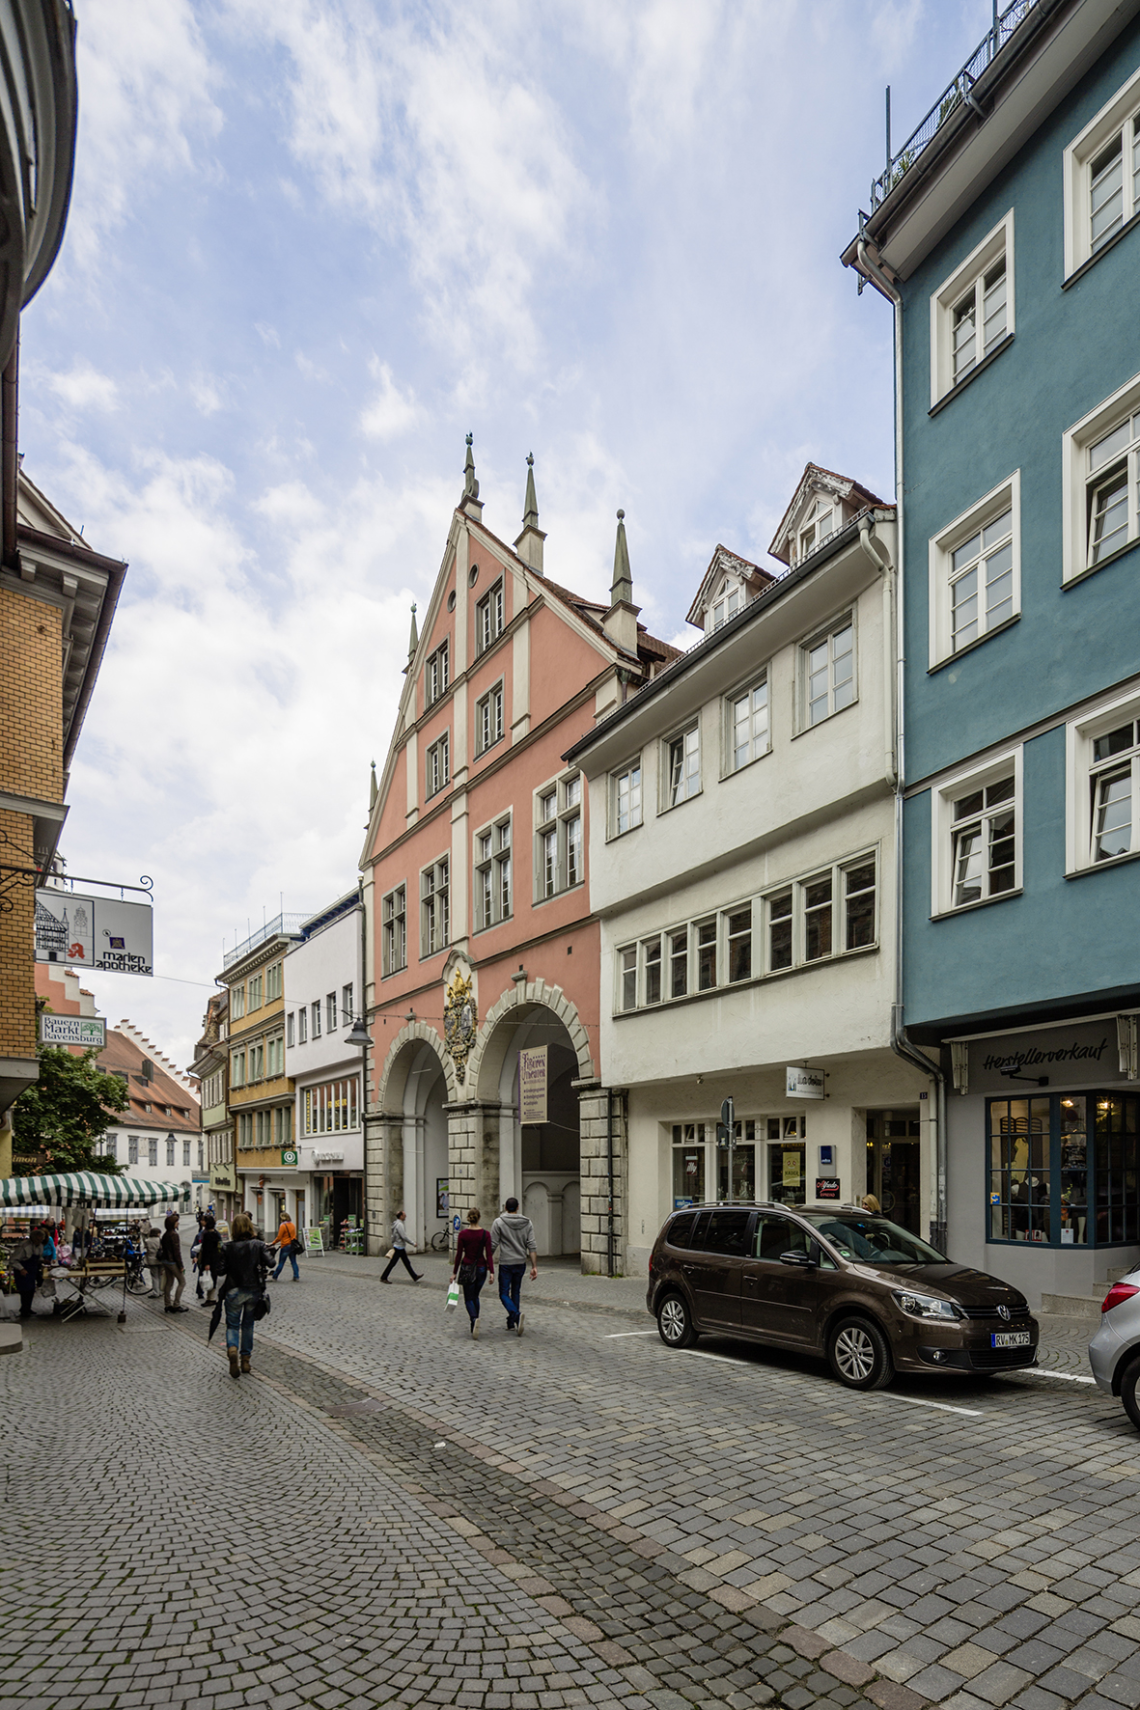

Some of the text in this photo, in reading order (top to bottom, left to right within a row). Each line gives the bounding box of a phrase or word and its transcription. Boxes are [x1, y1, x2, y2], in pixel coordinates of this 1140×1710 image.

[103, 951, 145, 964] marien
[95, 959, 153, 974] apotheke
[44, 1017, 80, 1027] Bauern
[44, 1024, 80, 1035] Markt
[44, 1031, 103, 1045] Ravensburg
[12, 1155, 37, 1163] imon
[996, 1333, 1030, 1346] RV MK 175
